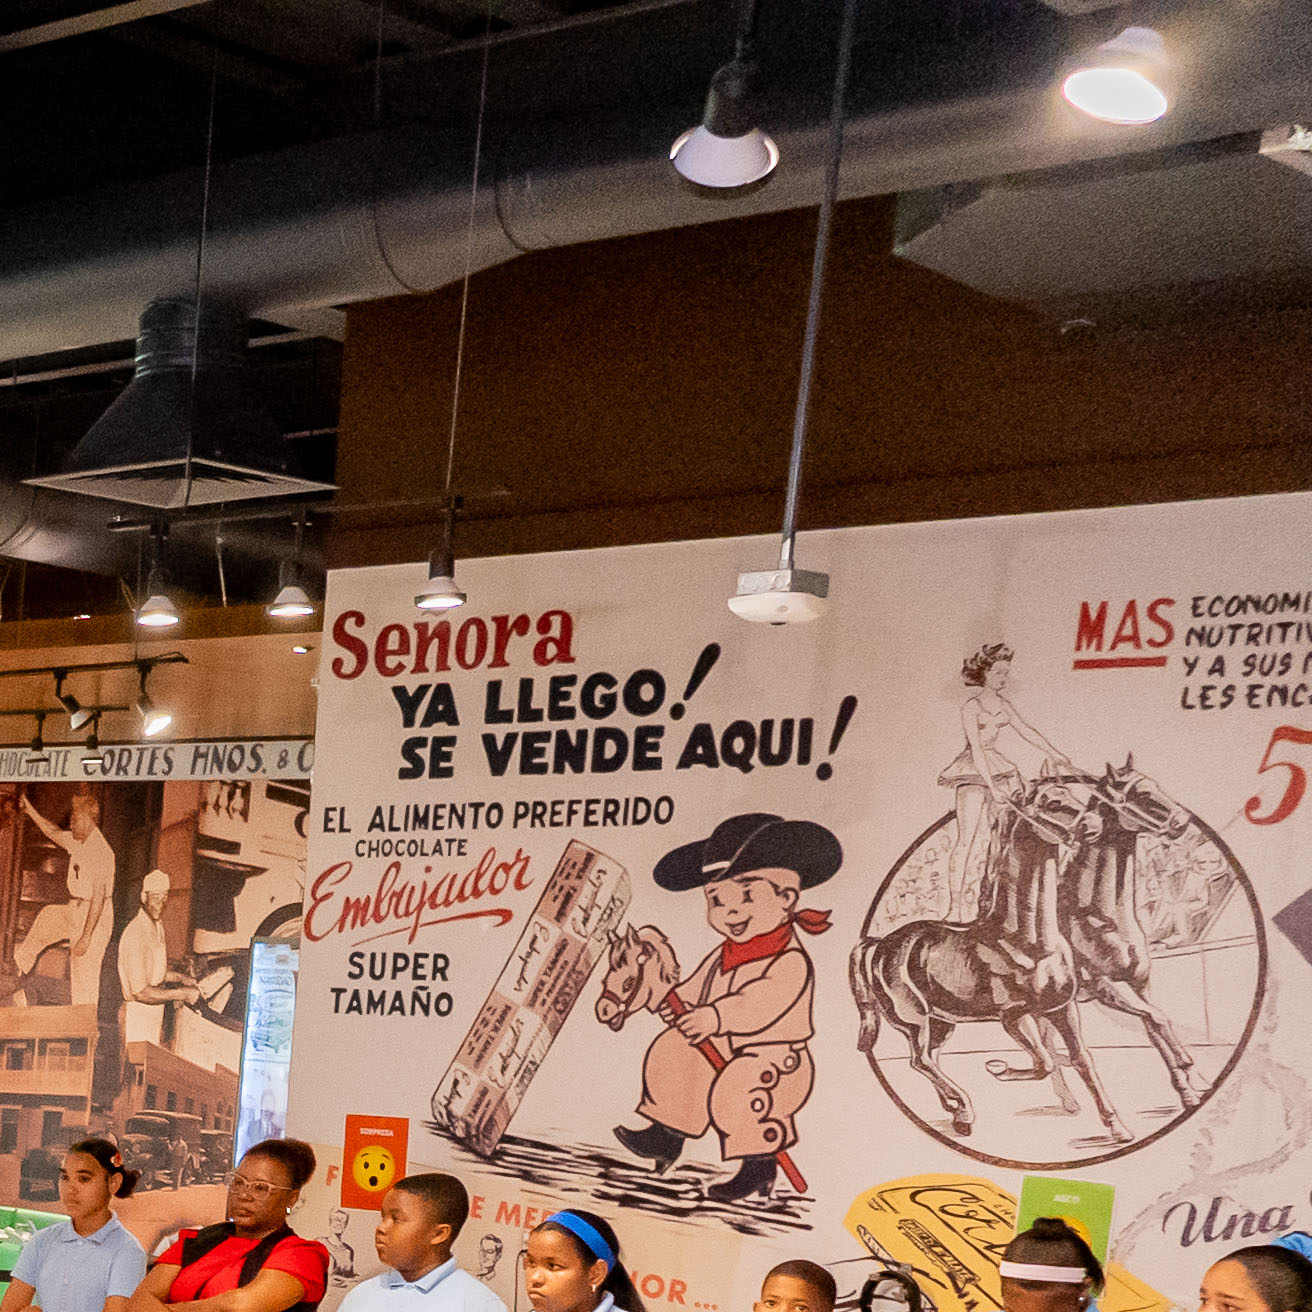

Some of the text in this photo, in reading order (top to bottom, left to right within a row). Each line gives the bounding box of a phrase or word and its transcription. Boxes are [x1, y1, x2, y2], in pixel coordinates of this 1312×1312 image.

[1076, 598, 1176, 652] MAS
[1183, 656, 1198, 677] Y
[1208, 655, 1226, 677] A
[1242, 652, 1292, 677] SUS
[391, 642, 721, 728] YA LLEGO!
[1181, 683, 1312, 710] LES ENC
[398, 695, 858, 781] SE VENDE AQUI!
[324, 795, 675, 833] EL ALIMENTO PREFERIDO
[355, 837, 468, 858] CHOCOLATE
[347, 952, 451, 981] SUPER
[330, 985, 454, 1017] TAMAÑO
[1162, 1196, 1296, 1248] Una
